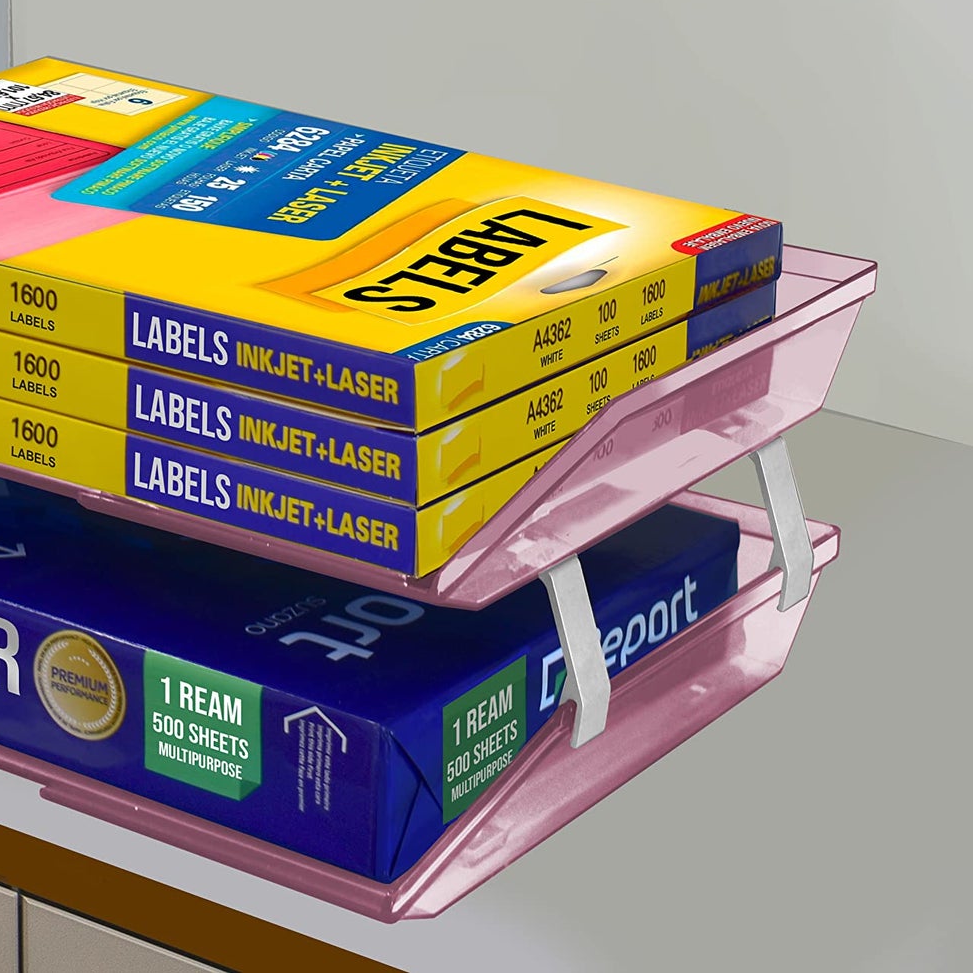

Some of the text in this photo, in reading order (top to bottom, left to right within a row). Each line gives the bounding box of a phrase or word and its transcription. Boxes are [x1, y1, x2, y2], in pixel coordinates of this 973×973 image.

[128, 97, 153, 106] 6
[267, 126, 330, 153] 6284
[282, 137, 366, 181] PAPEL CARTA
[337, 142, 417, 181] INKJET
[375, 149, 448, 184] ETIQUETA
[206, 176, 246, 191] 25
[171, 195, 218, 212] 150
[266, 187, 348, 224] LASER
[344, 208, 593, 311] LABELS
[11, 282, 57, 311] 1600
[642, 280, 665, 306] 1600
[10, 311, 55, 331] LABELS
[598, 299, 616, 324] 100
[641, 307, 663, 325] LABELS
[456, 323, 502, 340] 6284
[533, 317, 571, 352] A4362
[595, 326, 619, 344] SHEETS
[14, 351, 60, 380] 1600
[133, 312, 399, 405] LABELS INKJET+LASER
[541, 348, 563, 367] WHITE
[632, 346, 657, 374] 1600
[12, 378, 57, 397] LABELS
[589, 367, 608, 392] 100
[527, 388, 563, 424] A4362
[586, 395, 611, 414] SHEETS
[11, 418, 58, 447] 1600
[135, 385, 401, 479] LABELS INKJET+LASER
[534, 421, 556, 439] WHITE
[11, 446, 56, 467] LABELS
[134, 452, 399, 550] LABELS INKJET+LASER
[245, 596, 326, 635] suzano
[596, 574, 697, 667] eport
[51, 666, 108, 695] PREMIUM
[51, 681, 108, 706] PERFORMANCE
[160, 677, 242, 726] 1 REAM
[453, 684, 512, 746] 1 REAM
[152, 711, 249, 760] 500 SHEETS
[159, 741, 242, 780] MULTIPURPOSE
[447, 719, 517, 782] 500 SHEETS
[451, 750, 513, 803] MULTIPURPOSE
